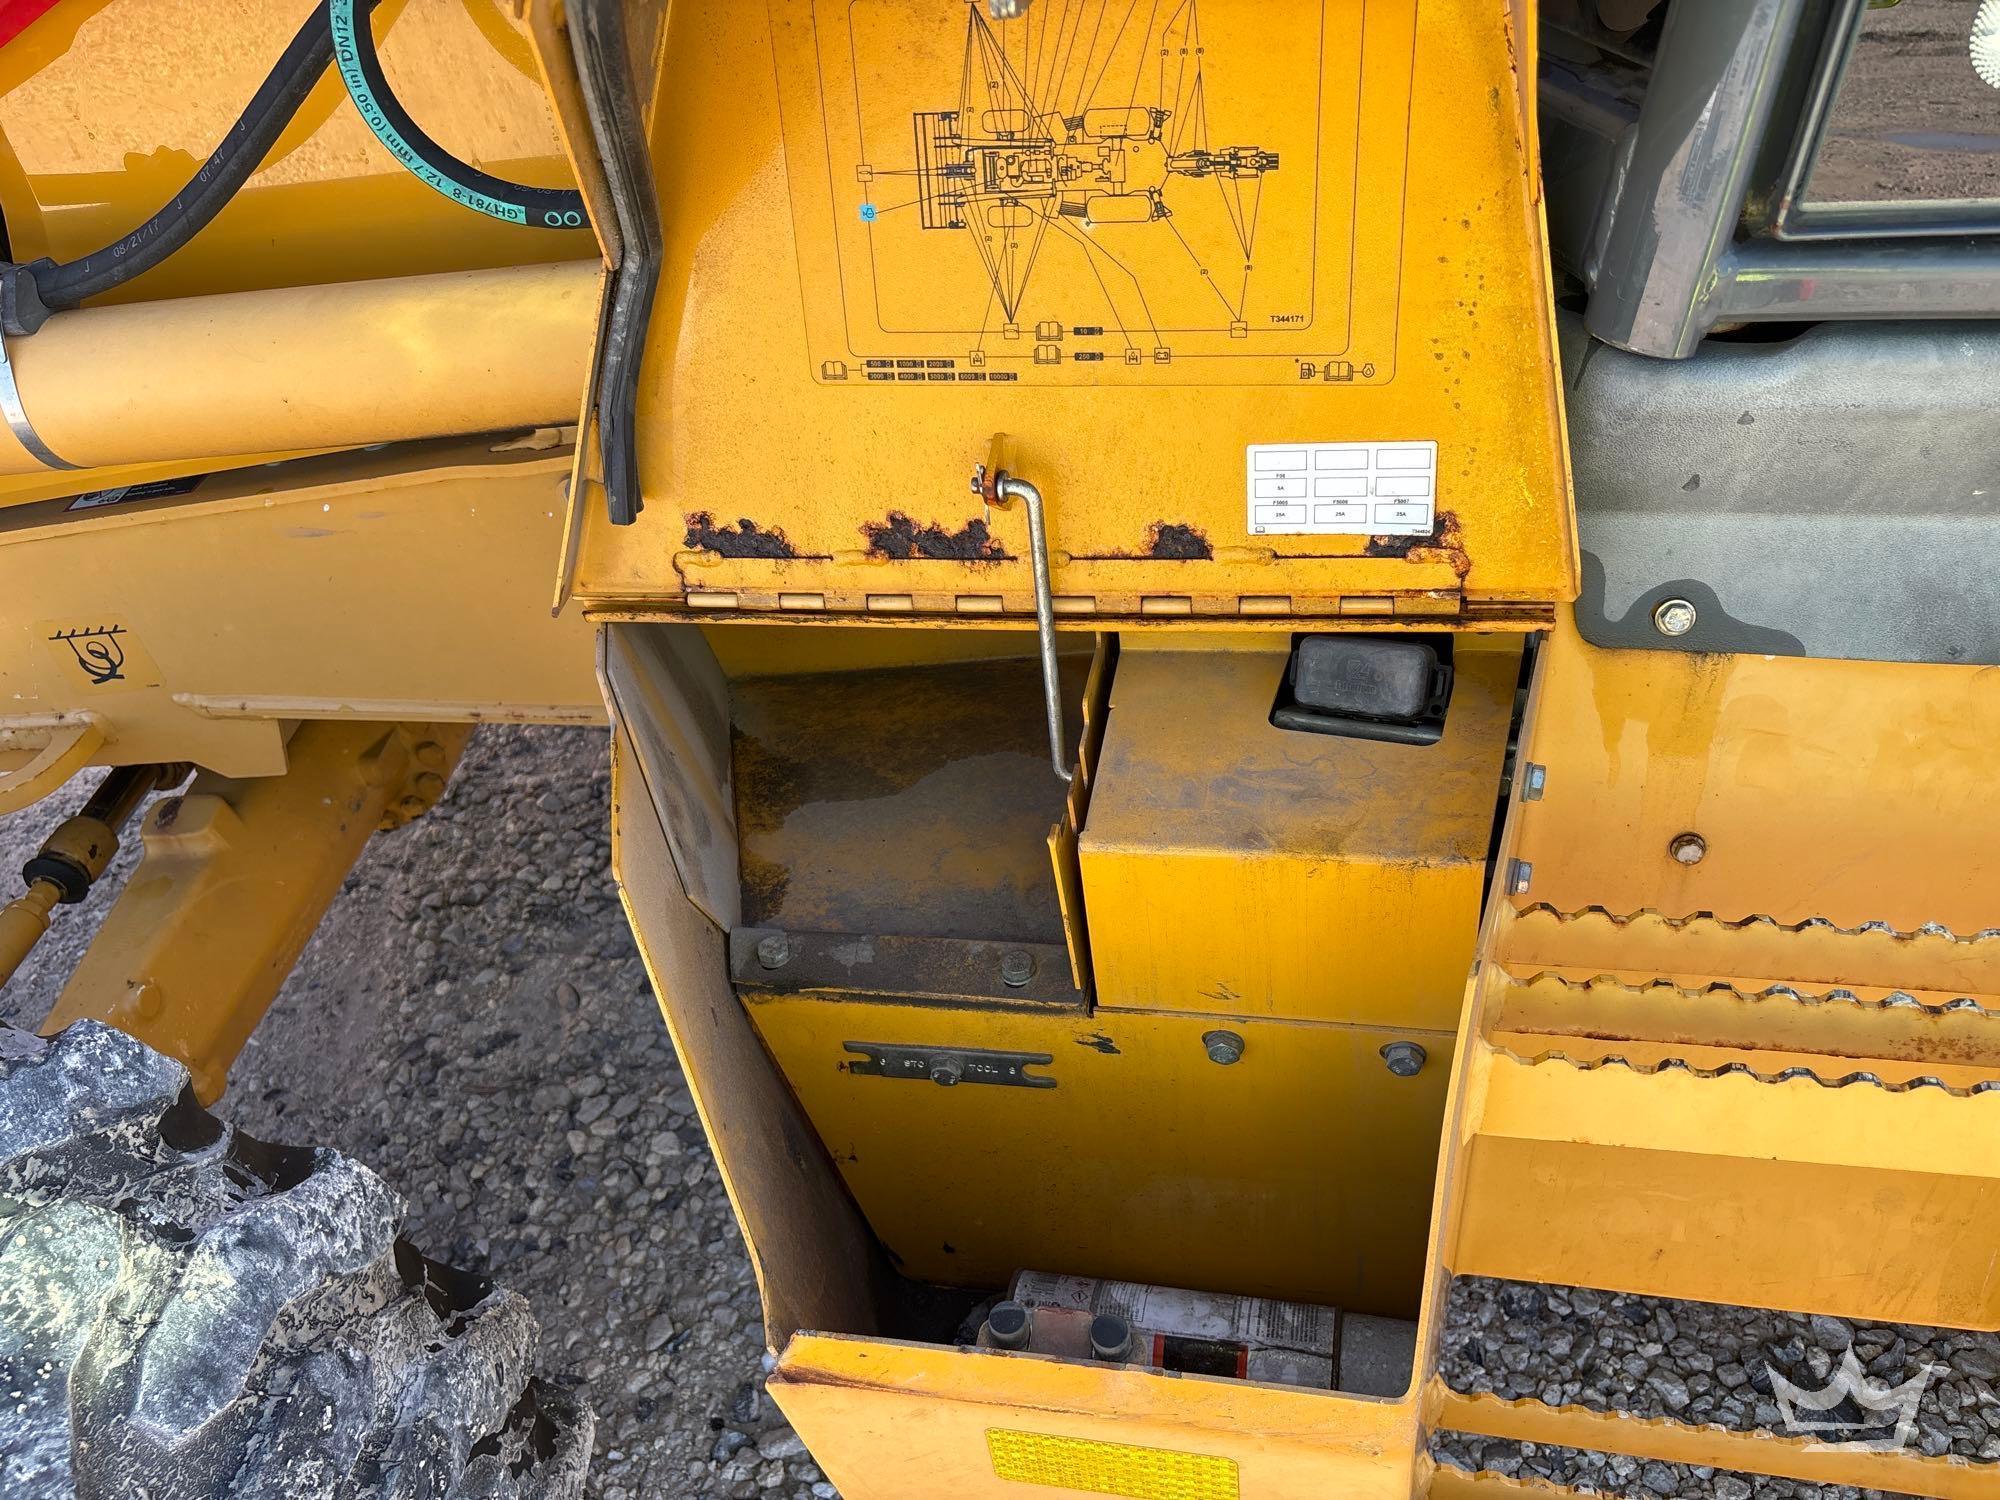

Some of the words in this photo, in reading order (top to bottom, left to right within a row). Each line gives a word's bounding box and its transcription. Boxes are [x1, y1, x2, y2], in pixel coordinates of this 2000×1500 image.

[336, 15, 354, 62] DN12
[344, 65, 362, 89] in)
[989, 81, 999, 90] (2)
[357, 93, 387, 133] (0.50
[386, 131, 414, 163] mm
[414, 164, 442, 189] 12.7
[113, 218, 159, 258] 08/21/17
[200, 148, 225, 182] 07:47
[453, 187, 519, 220] GH781-8
[1270, 315, 1304, 323] T344171
